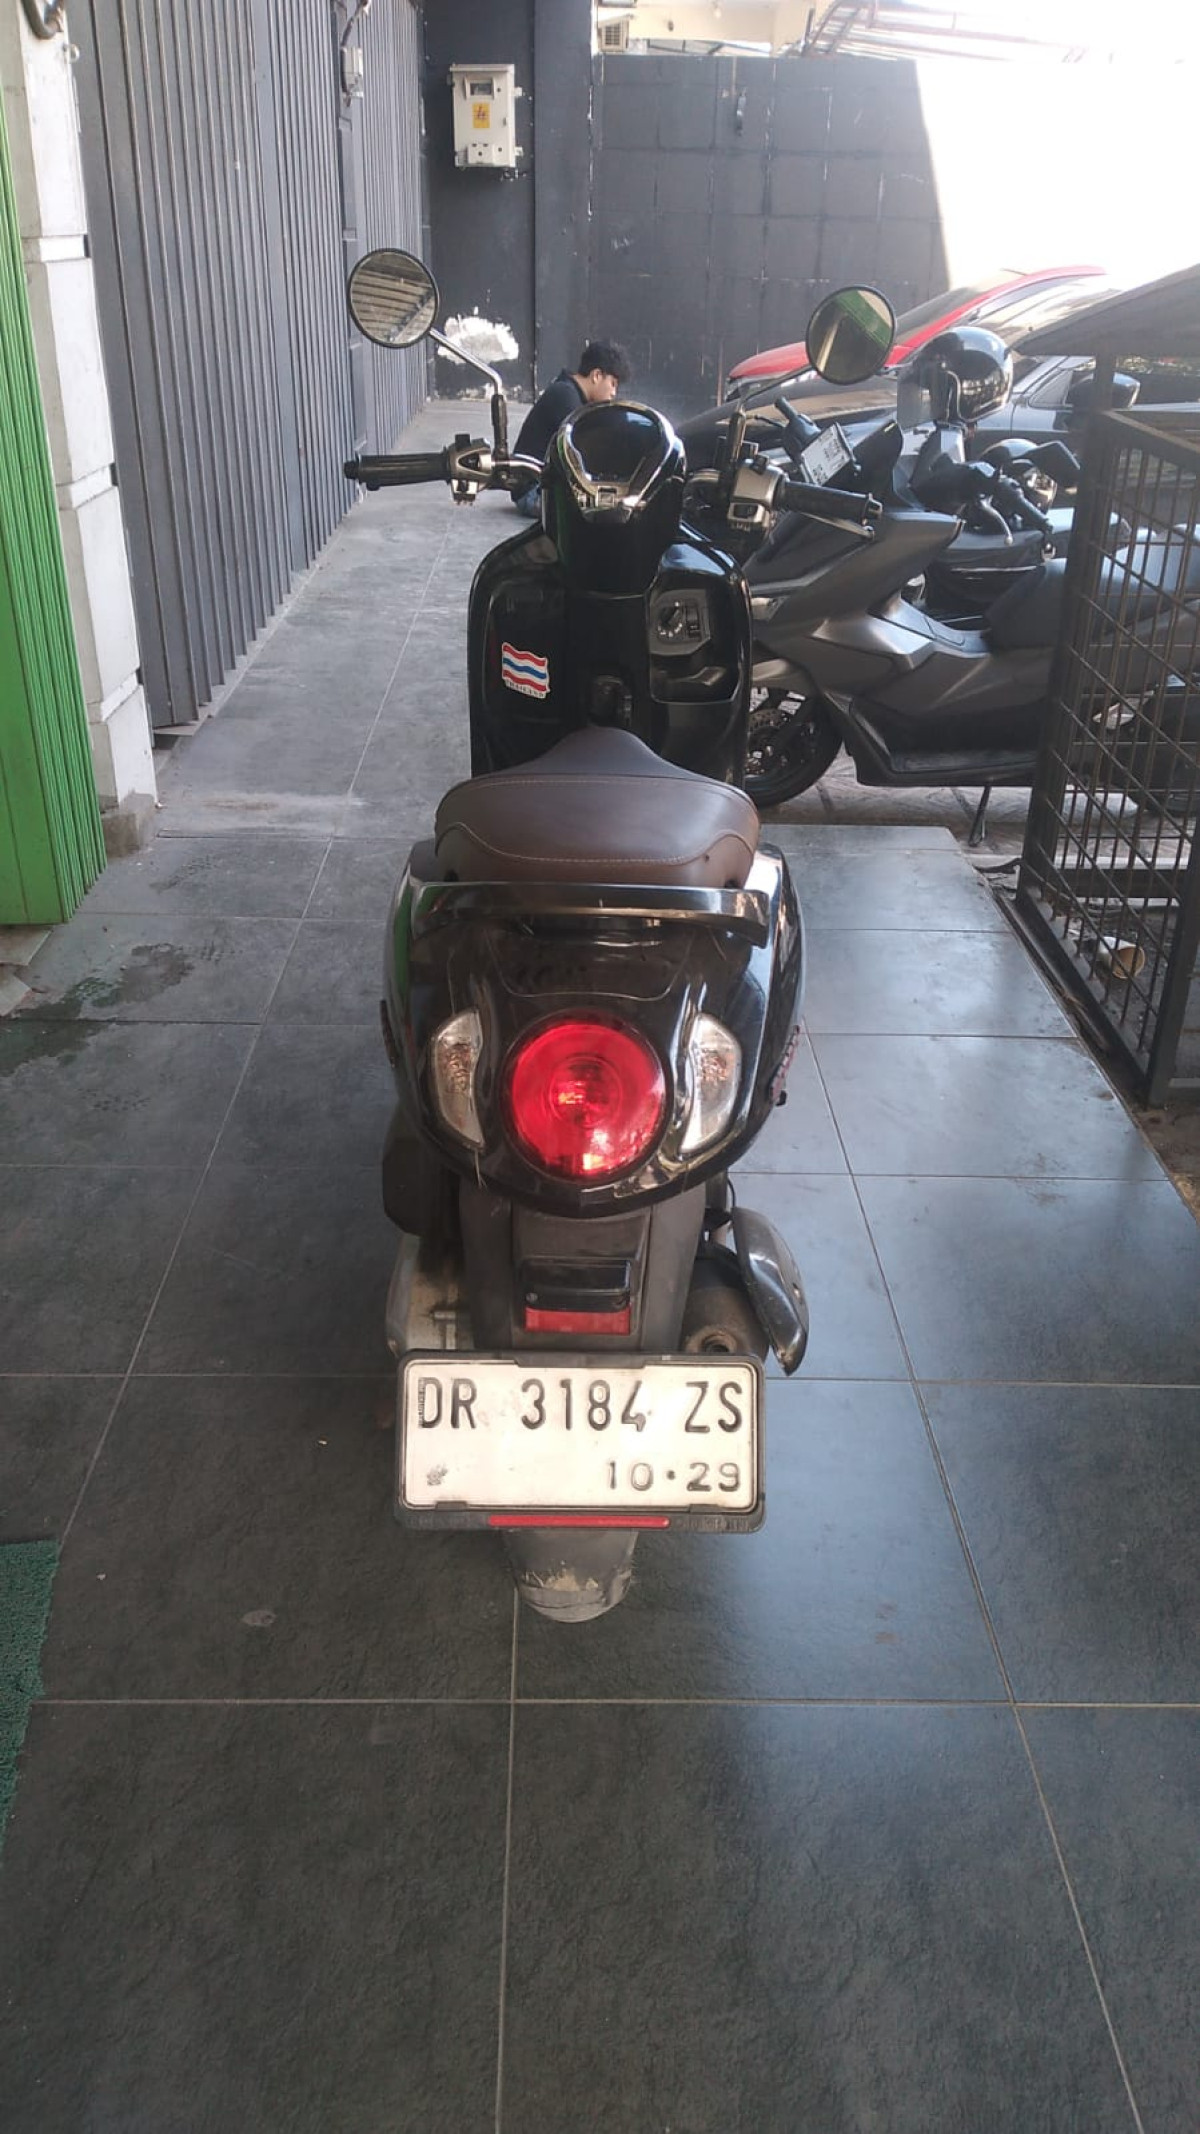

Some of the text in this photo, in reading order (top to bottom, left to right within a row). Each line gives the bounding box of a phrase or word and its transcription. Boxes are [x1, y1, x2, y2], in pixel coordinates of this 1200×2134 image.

[418, 1376, 743, 1433] DR 3184 ZS
